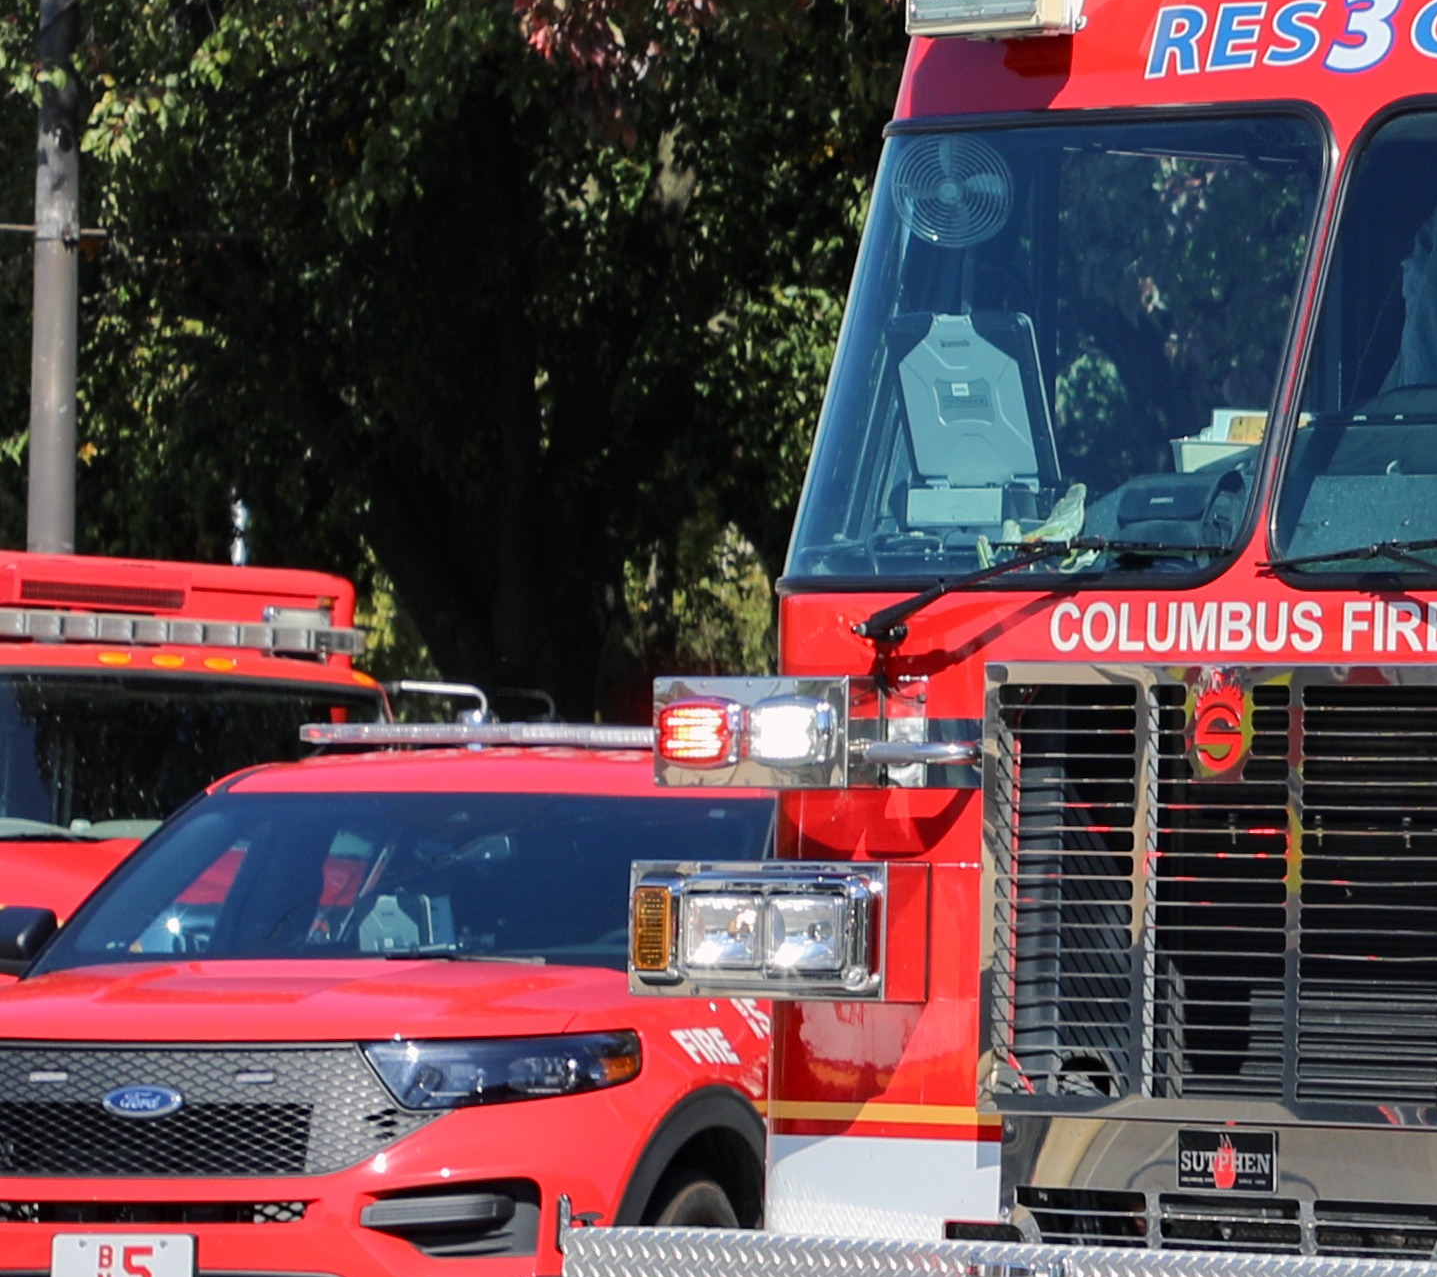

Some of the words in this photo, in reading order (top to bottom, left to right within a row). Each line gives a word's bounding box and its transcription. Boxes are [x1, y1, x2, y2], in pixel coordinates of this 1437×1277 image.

[1049, 600, 1324, 653] COLUMBUS
[669, 1026, 742, 1065] FIRE
[119, 1091, 161, 1110] Ford
[1180, 1149, 1271, 1175] SUTPHEN
